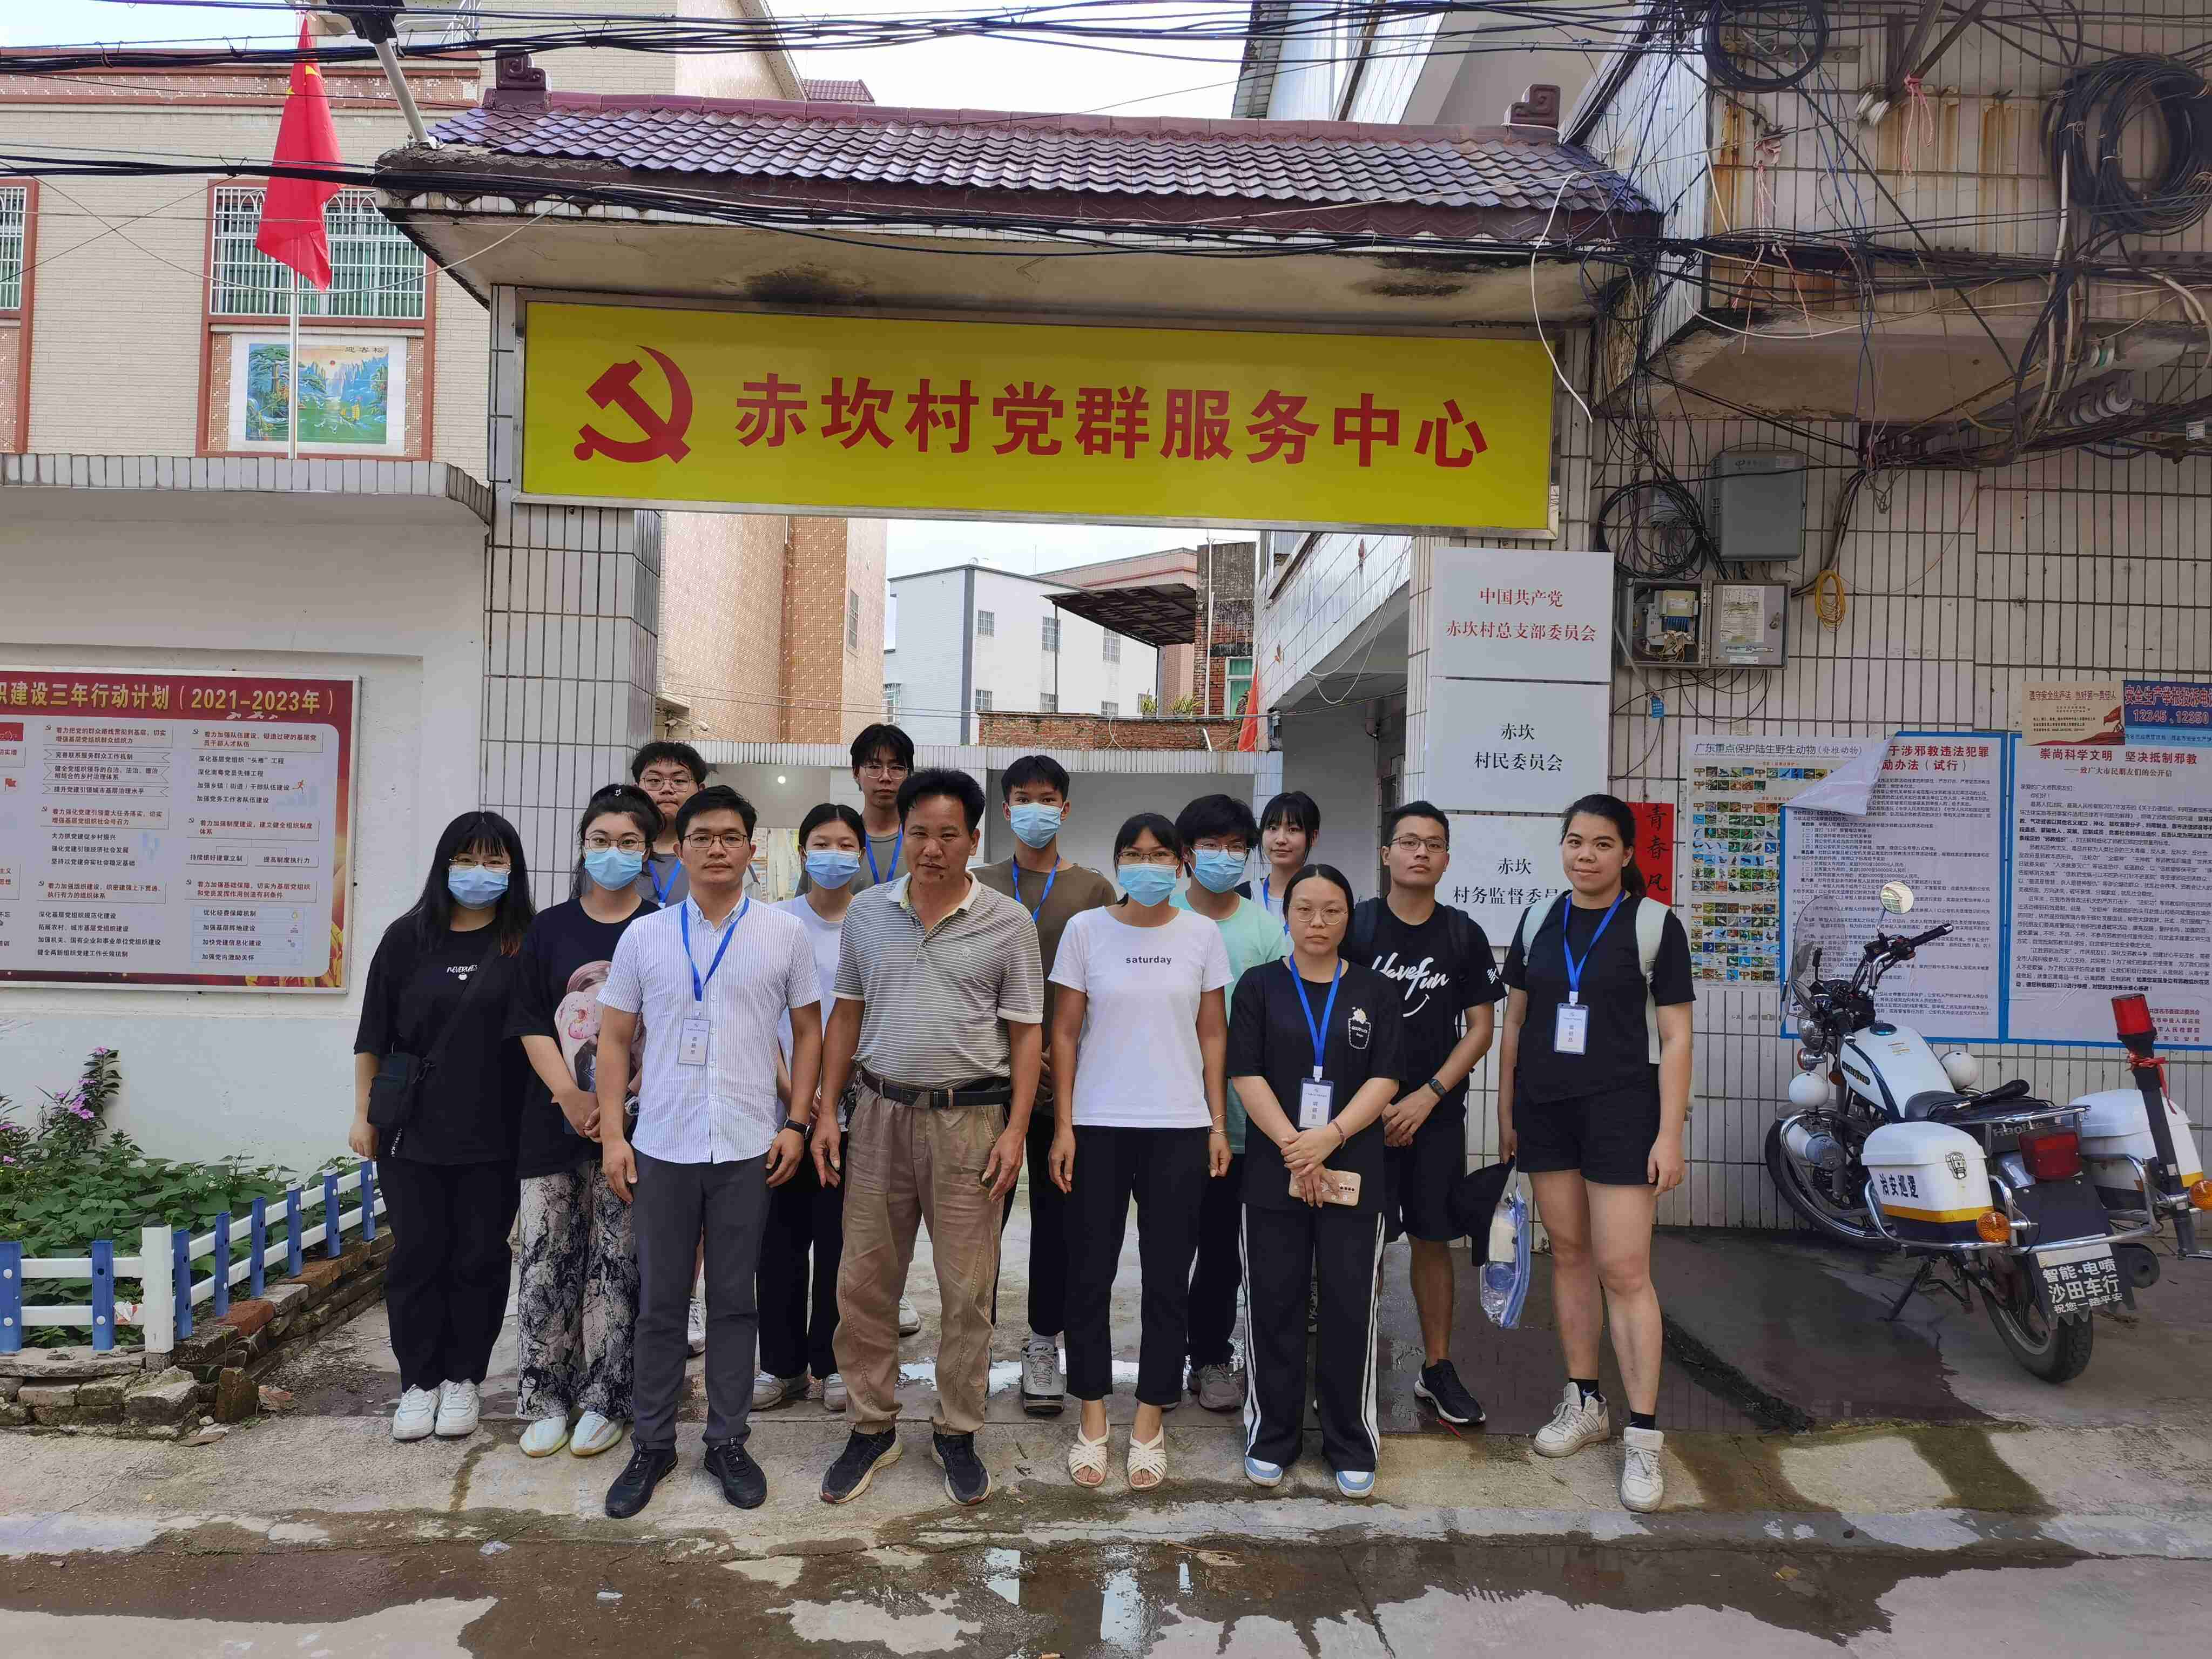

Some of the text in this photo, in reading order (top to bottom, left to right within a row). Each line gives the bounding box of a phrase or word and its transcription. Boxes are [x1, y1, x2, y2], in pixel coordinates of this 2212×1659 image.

[735, 373, 1489, 469] 赤坎村党群服务中心
[1479, 588, 1563, 608] 中国共产党
[1445, 621, 1597, 642] 赤坎村总支部委员会
[2125, 685, 2212, 707] 安全生产举报投诉电
[1500, 723, 1535, 740] 赤坎
[56, 736, 133, 744] 增强基层党组织群众组织力
[56, 752, 133, 760] 完善联系服务群众工作机制
[2040, 747, 2197, 765] 崇尚科学文明 坚决抵制邪教
[1474, 751, 1563, 772] 村民委员会
[54, 786, 144, 795] 提升党建引领城市基层治理水平
[197, 795, 269, 804] 加强党务工作者队伍建设
[190, 854, 242, 862] 持续抓好建章立制
[1497, 858, 1532, 875] 赤坎
[38, 911, 116, 919] 深化基层党组织规范化建设
[203, 909, 256, 917] 优化经费保障机制
[203, 924, 255, 932] 加强基层阵地建设
[202, 939, 261, 947] 加快党建信息化建设
[37, 949, 128, 957] 健全两新组织党建工作长效机制
[201, 953, 255, 961] 加强党内激励关怀
[1126, 955, 1171, 965] saturday
[1879, 1173, 1919, 1198] 治安巡逻
[2048, 1274, 2120, 1304] 沙田车行
[2053, 1292, 2123, 1314] 祝您一路平安
